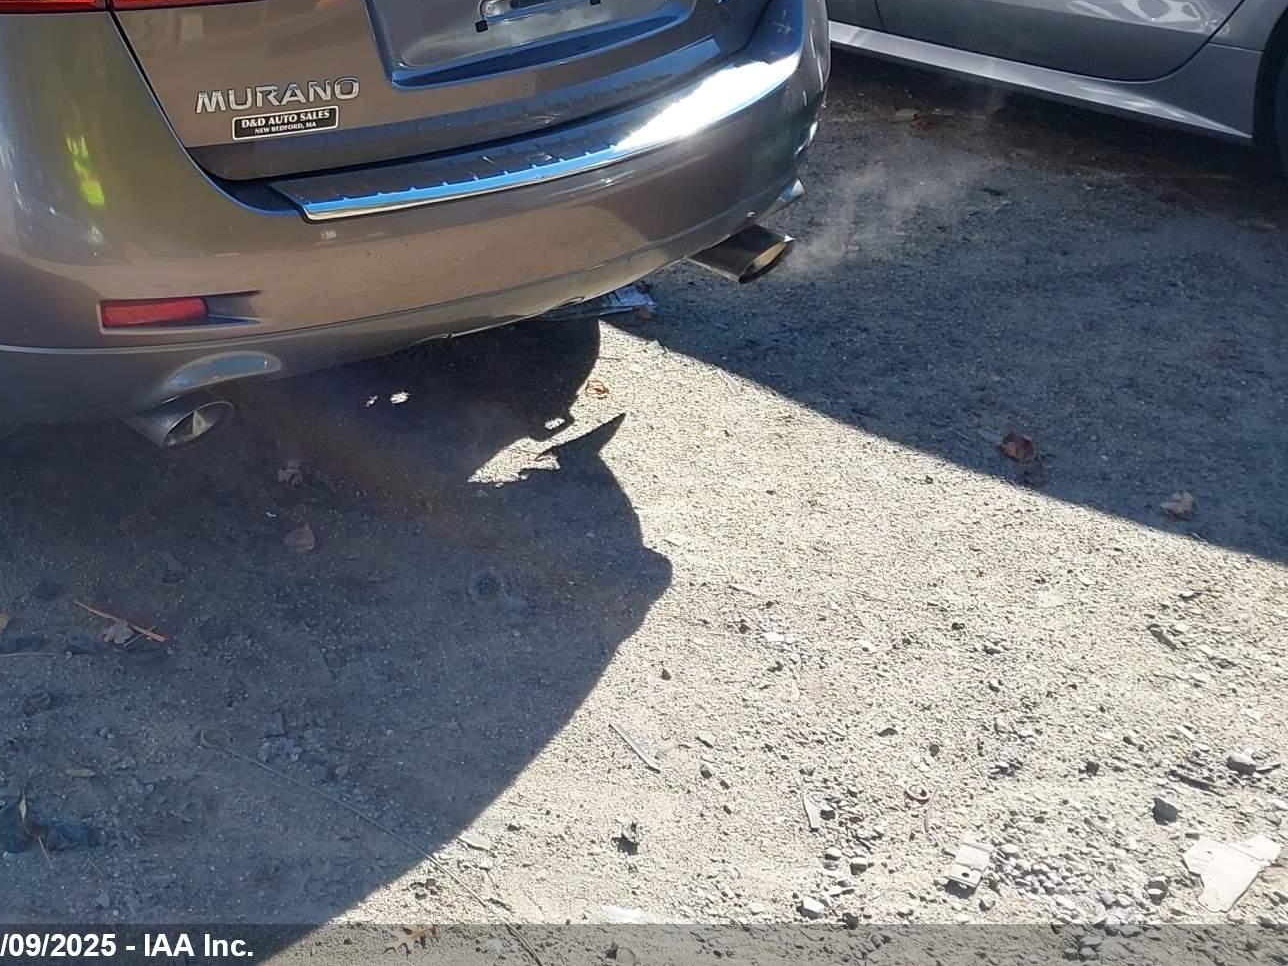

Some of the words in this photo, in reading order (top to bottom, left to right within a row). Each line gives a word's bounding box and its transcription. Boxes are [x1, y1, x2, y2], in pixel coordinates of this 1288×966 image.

[195, 76, 360, 114] MURANO
[241, 117, 265, 129] D&D
[268, 113, 298, 126] AUTO
[299, 109, 330, 122] SALES
[255, 126, 270, 134] NEW
[271, 122, 305, 132] BEDFORD,
